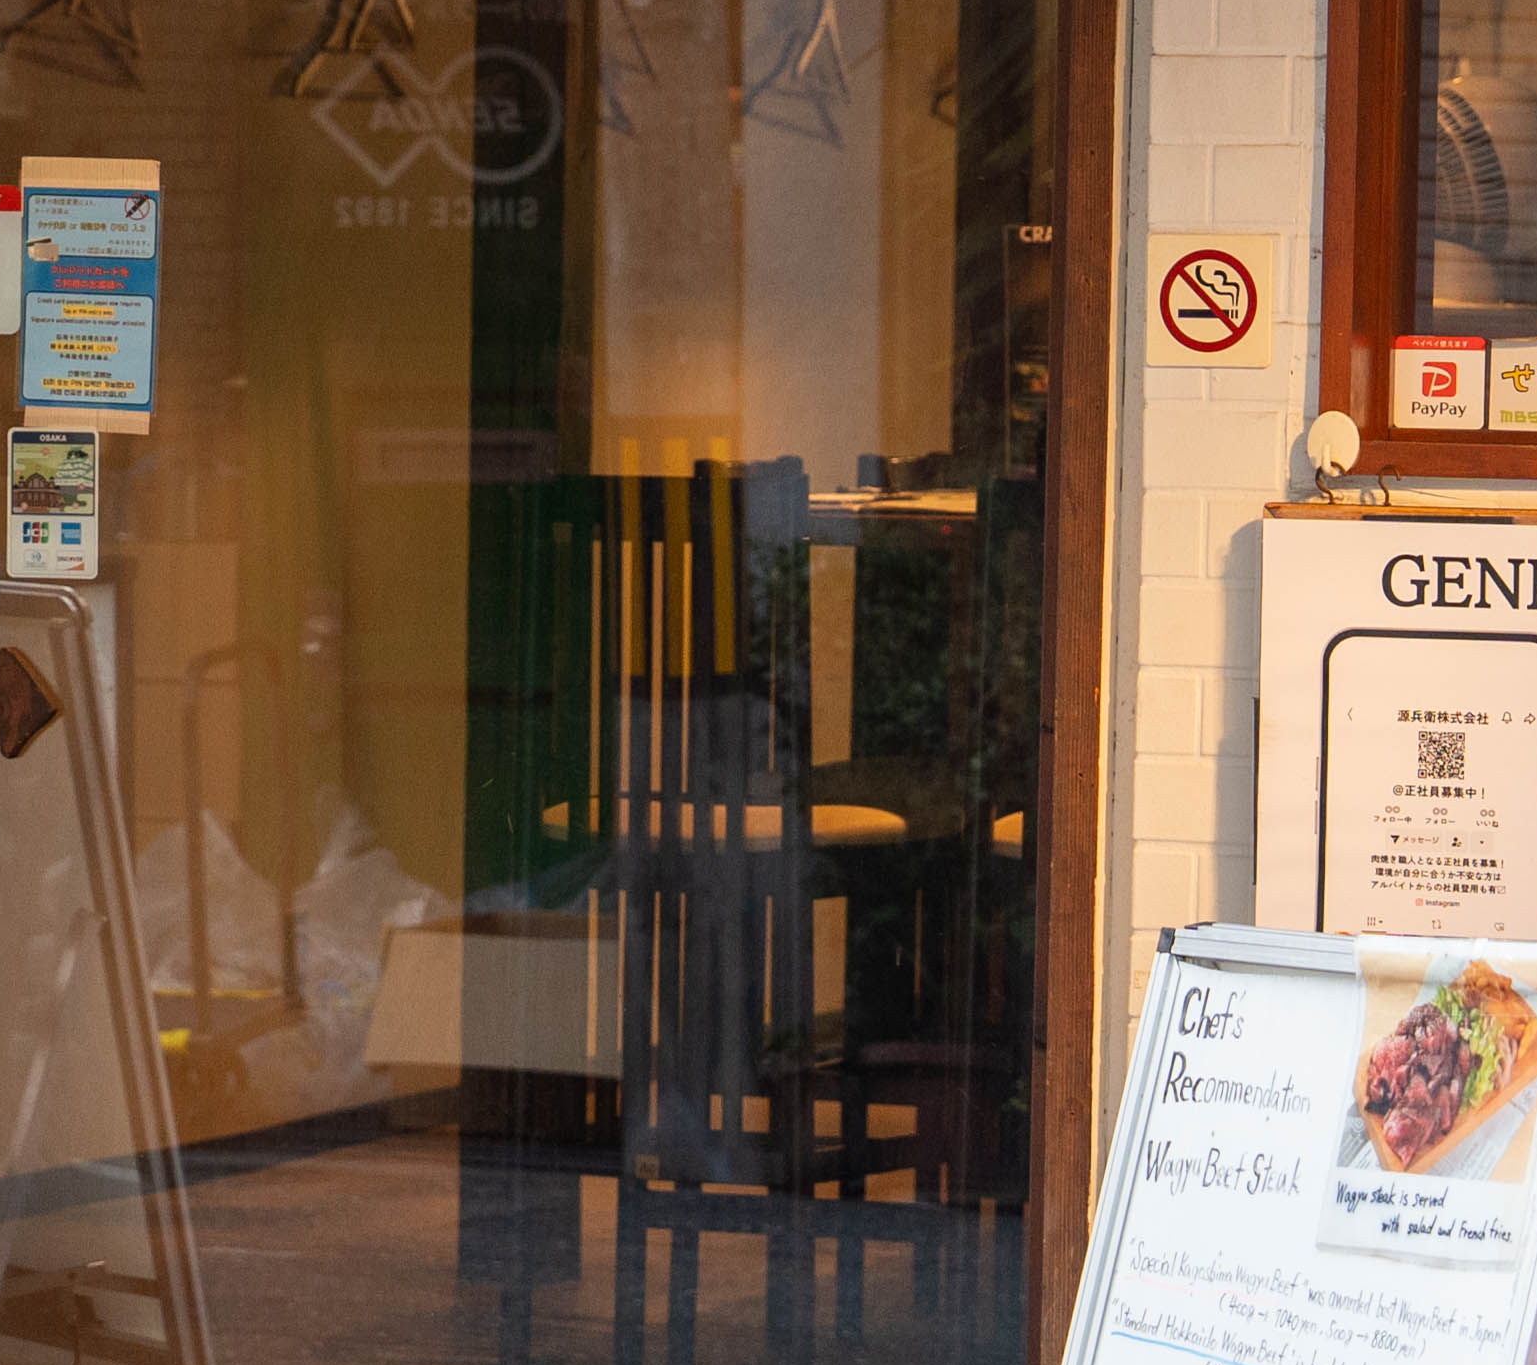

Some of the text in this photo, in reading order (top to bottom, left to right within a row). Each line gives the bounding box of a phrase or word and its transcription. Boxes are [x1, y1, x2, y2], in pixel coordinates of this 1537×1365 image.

[1412, 402, 1467, 417] PayPay
[1397, 710, 1489, 725] 源兵衛株式会社
[1425, 899, 1461, 908] Instagram
[1178, 987, 1247, 1039] Chef's
[1162, 1050, 1311, 1115] Recommendation
[1145, 1139, 1201, 1195] Wagyu
[1246, 1152, 1303, 1197] Steak
[1336, 1180, 1449, 1213] Wagyu steak is served
[1407, 1216, 1435, 1237] salad
[1437, 1220, 1455, 1238] and
[1458, 1219, 1487, 1241] French
[1371, 1330, 1399, 1352] 8800
